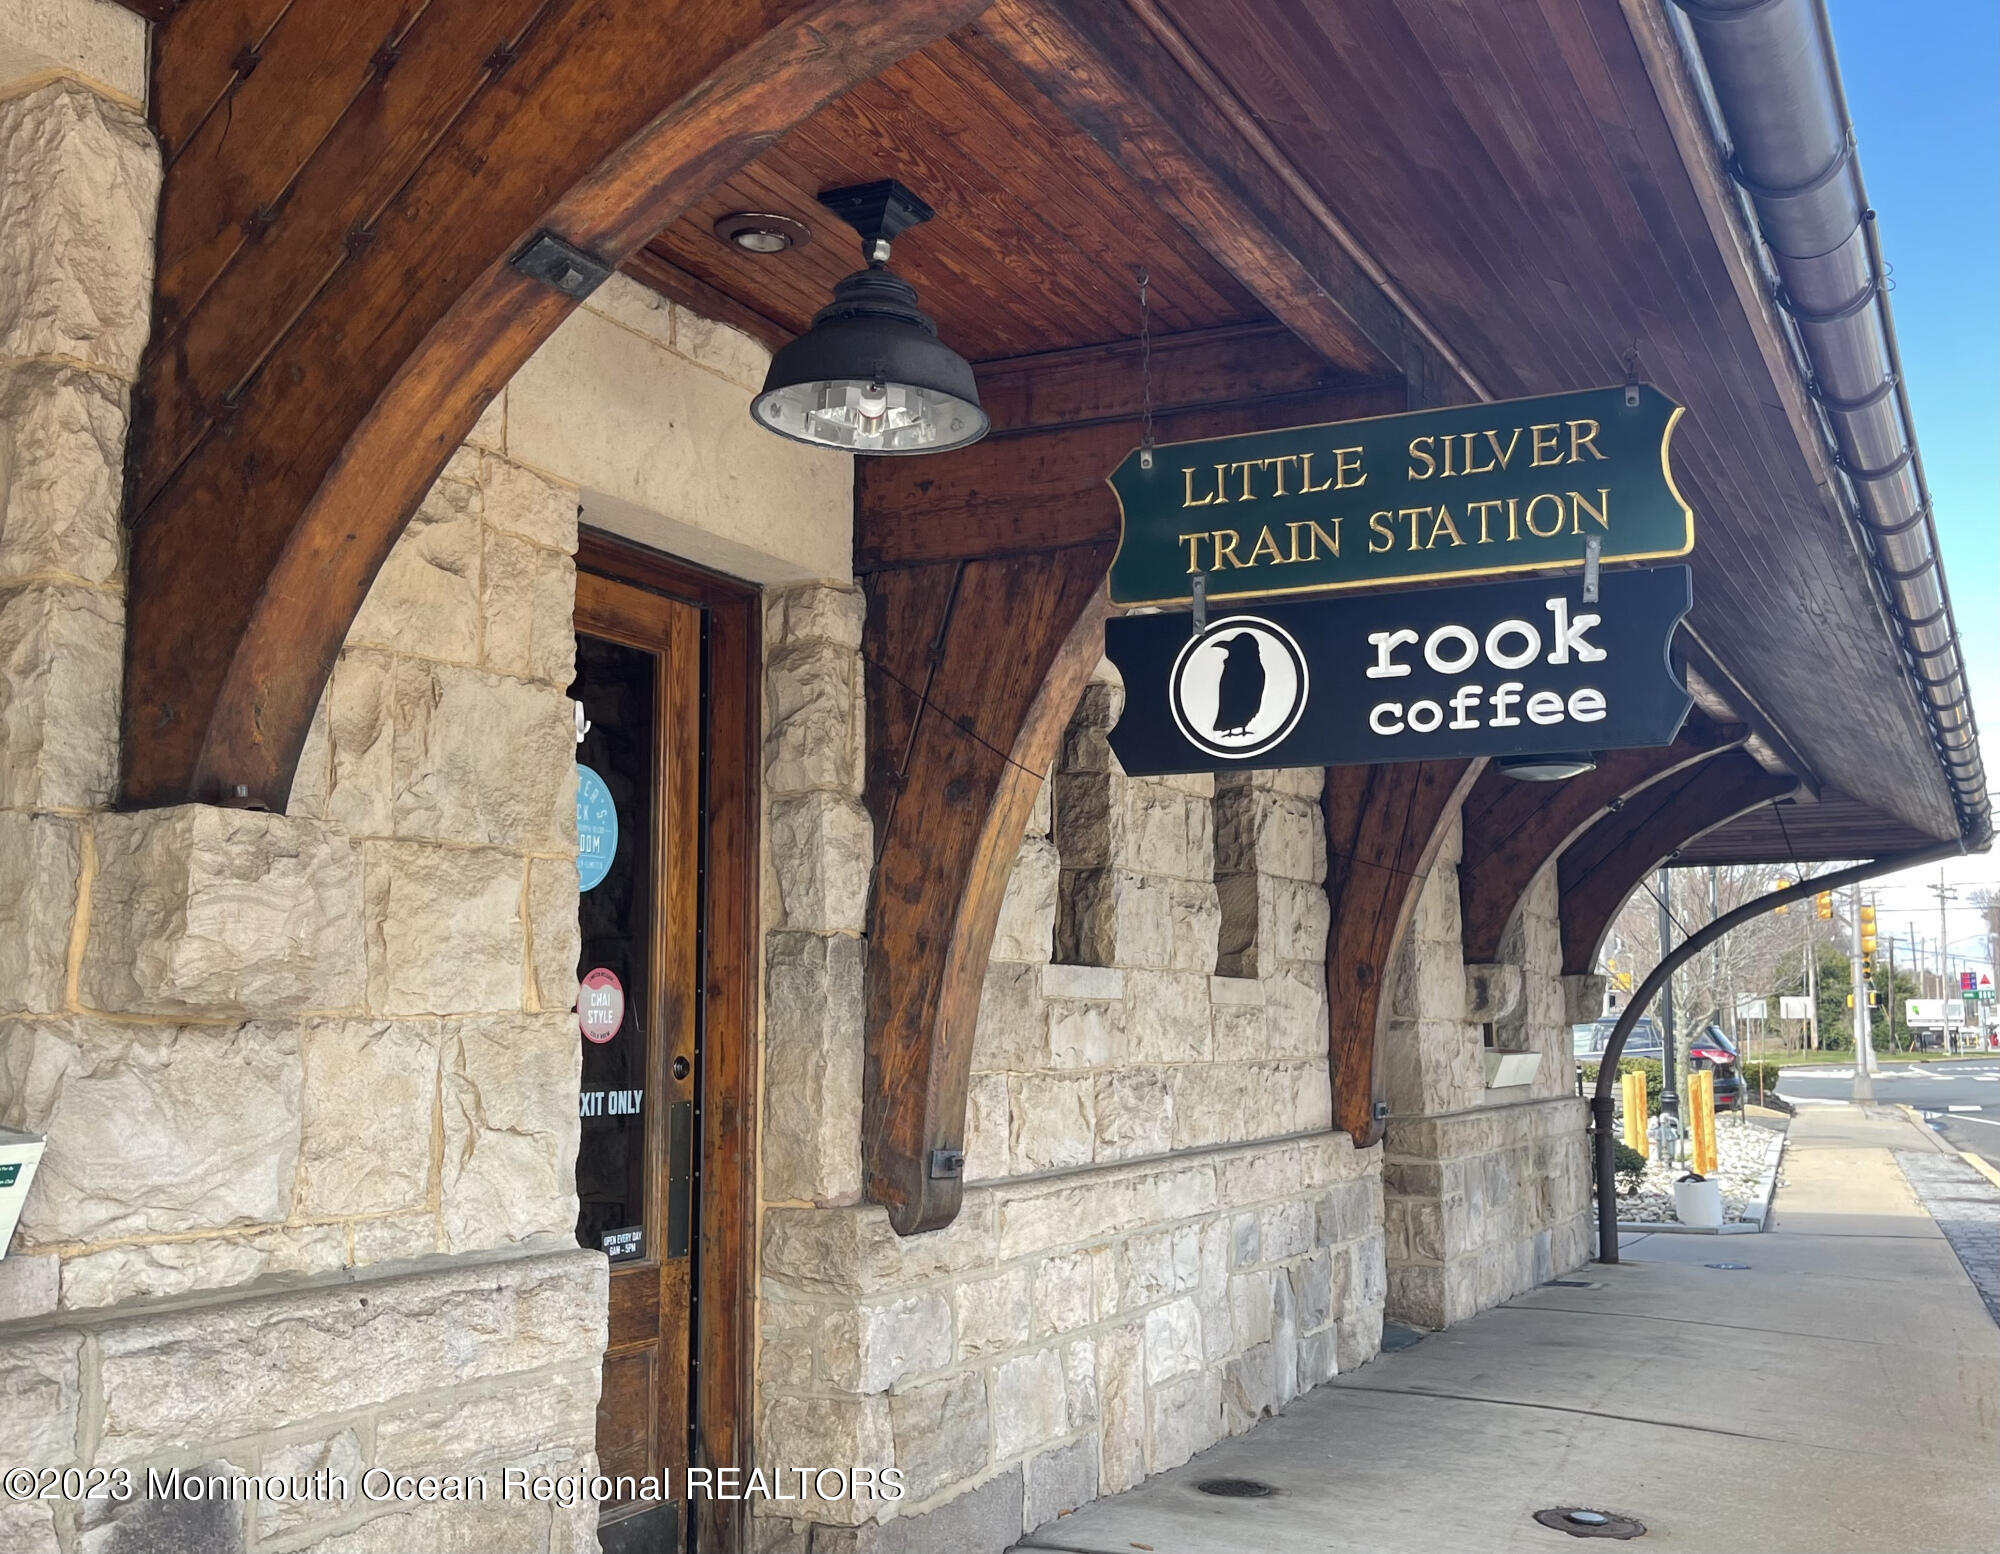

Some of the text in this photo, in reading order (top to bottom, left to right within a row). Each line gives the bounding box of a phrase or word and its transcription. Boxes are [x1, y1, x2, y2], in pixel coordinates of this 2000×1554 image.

[1181, 419, 1609, 508] LITTLE SILVER
[1179, 488, 1610, 574] TRAIN STATION
[1366, 598, 1607, 678] rook
[1369, 682, 1607, 735] coffee
[588, 1010, 613, 1024] STYLE
[591, 993, 611, 1007] CHAI
[608, 1090, 643, 1115] ONLY
[604, 1231, 642, 1246] OPEN EVERY DAY
